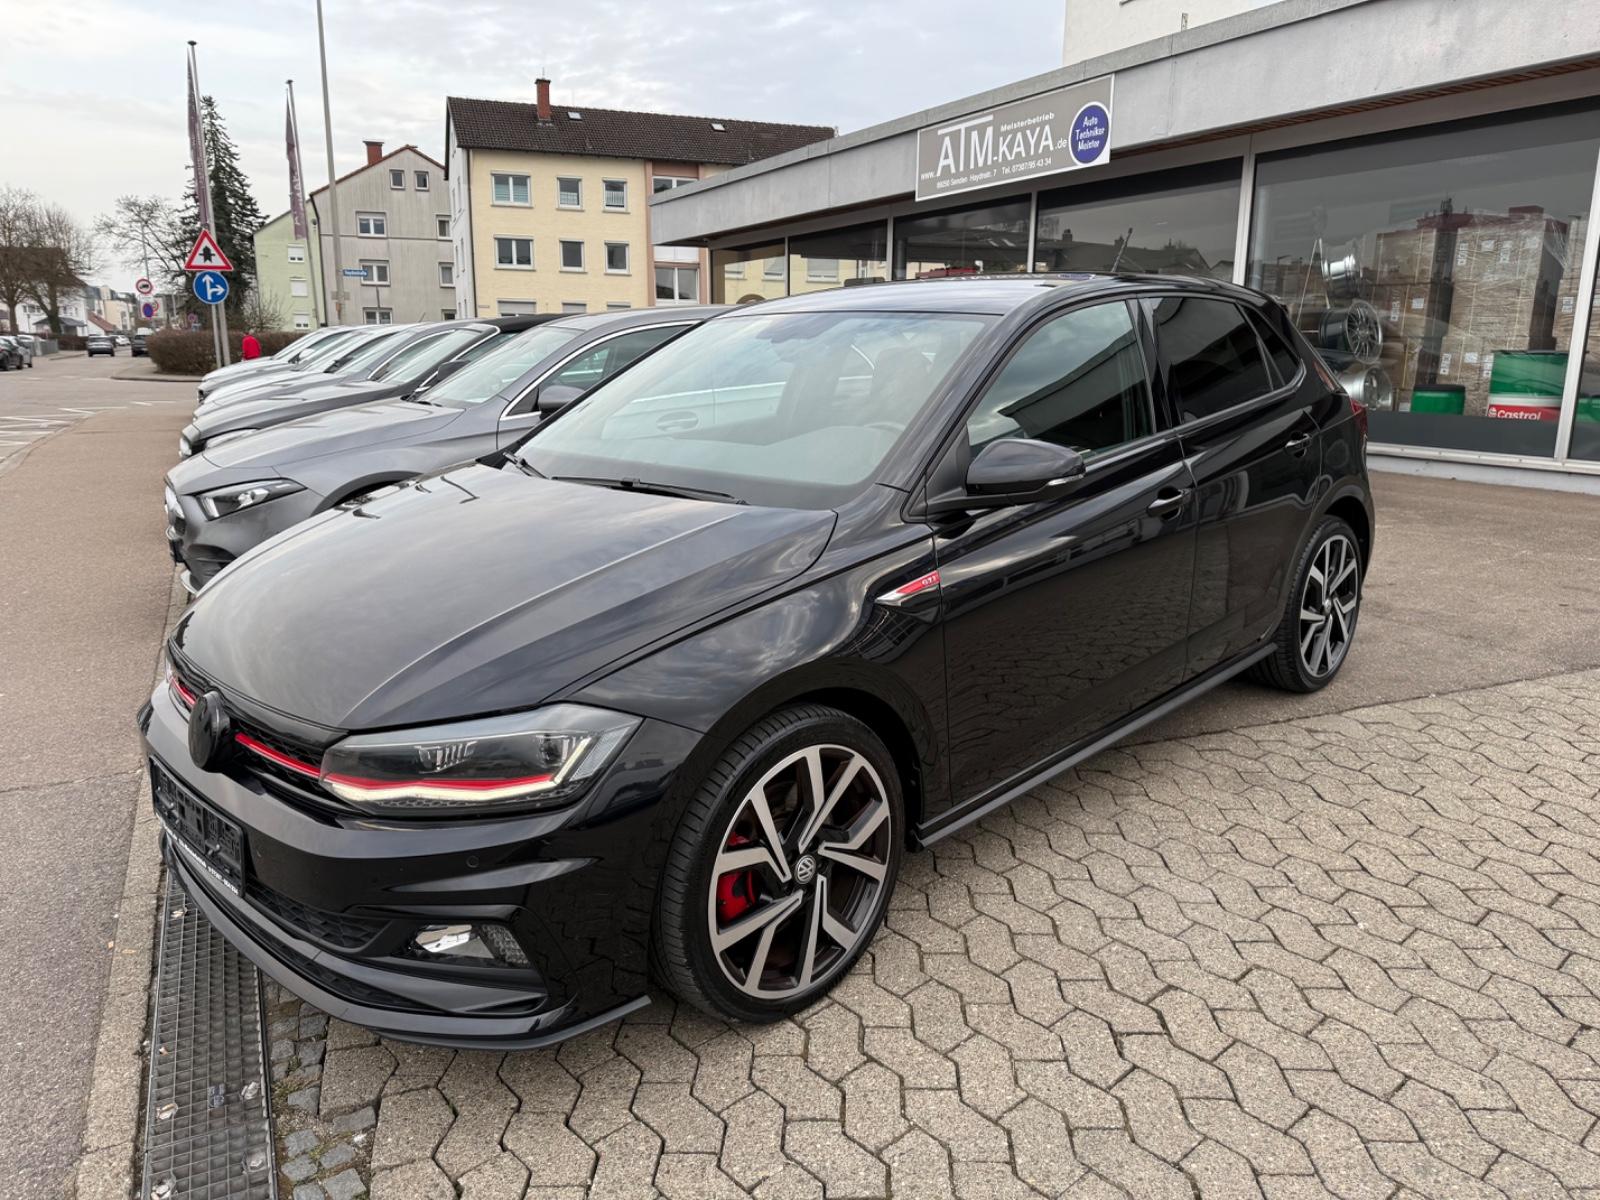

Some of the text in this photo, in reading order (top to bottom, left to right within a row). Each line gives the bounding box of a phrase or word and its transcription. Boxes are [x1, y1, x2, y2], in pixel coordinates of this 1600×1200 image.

[1000, 112, 1055, 131] Meisterbetrieb
[1082, 116, 1098, 127] Auto
[1075, 126, 1105, 140] Techniker
[1078, 140, 1100, 151] Meister
[1497, 409, 1541, 420] Castrol
[922, 576, 936, 585] GTI
